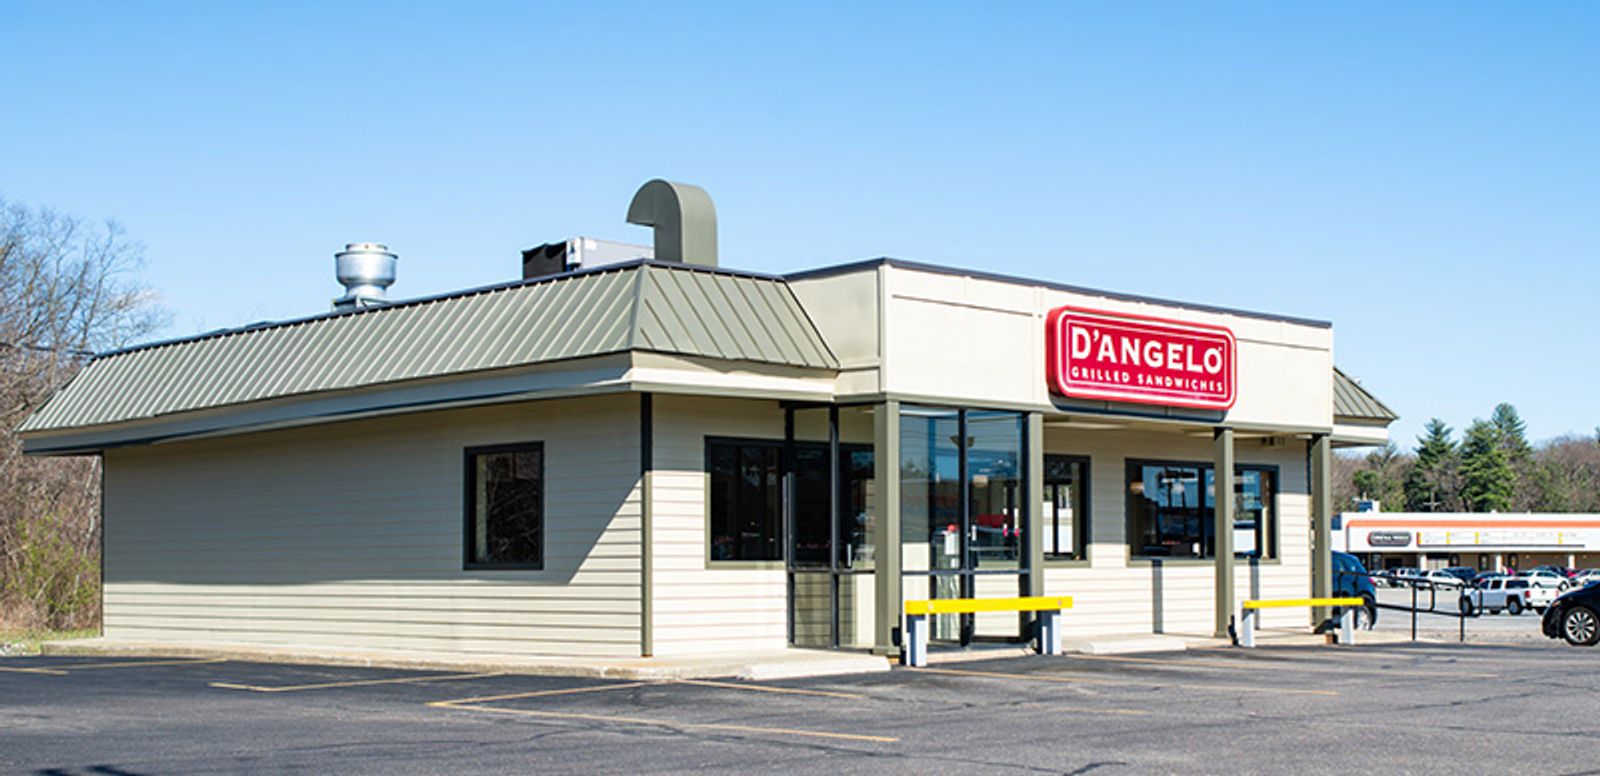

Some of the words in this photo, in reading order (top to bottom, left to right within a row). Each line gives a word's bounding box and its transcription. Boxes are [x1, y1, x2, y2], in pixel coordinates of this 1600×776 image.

[1071, 326, 1223, 374] D'ANGELO
[1071, 366, 1130, 382] GRILLED
[1137, 373, 1223, 392] SANDWICHES
